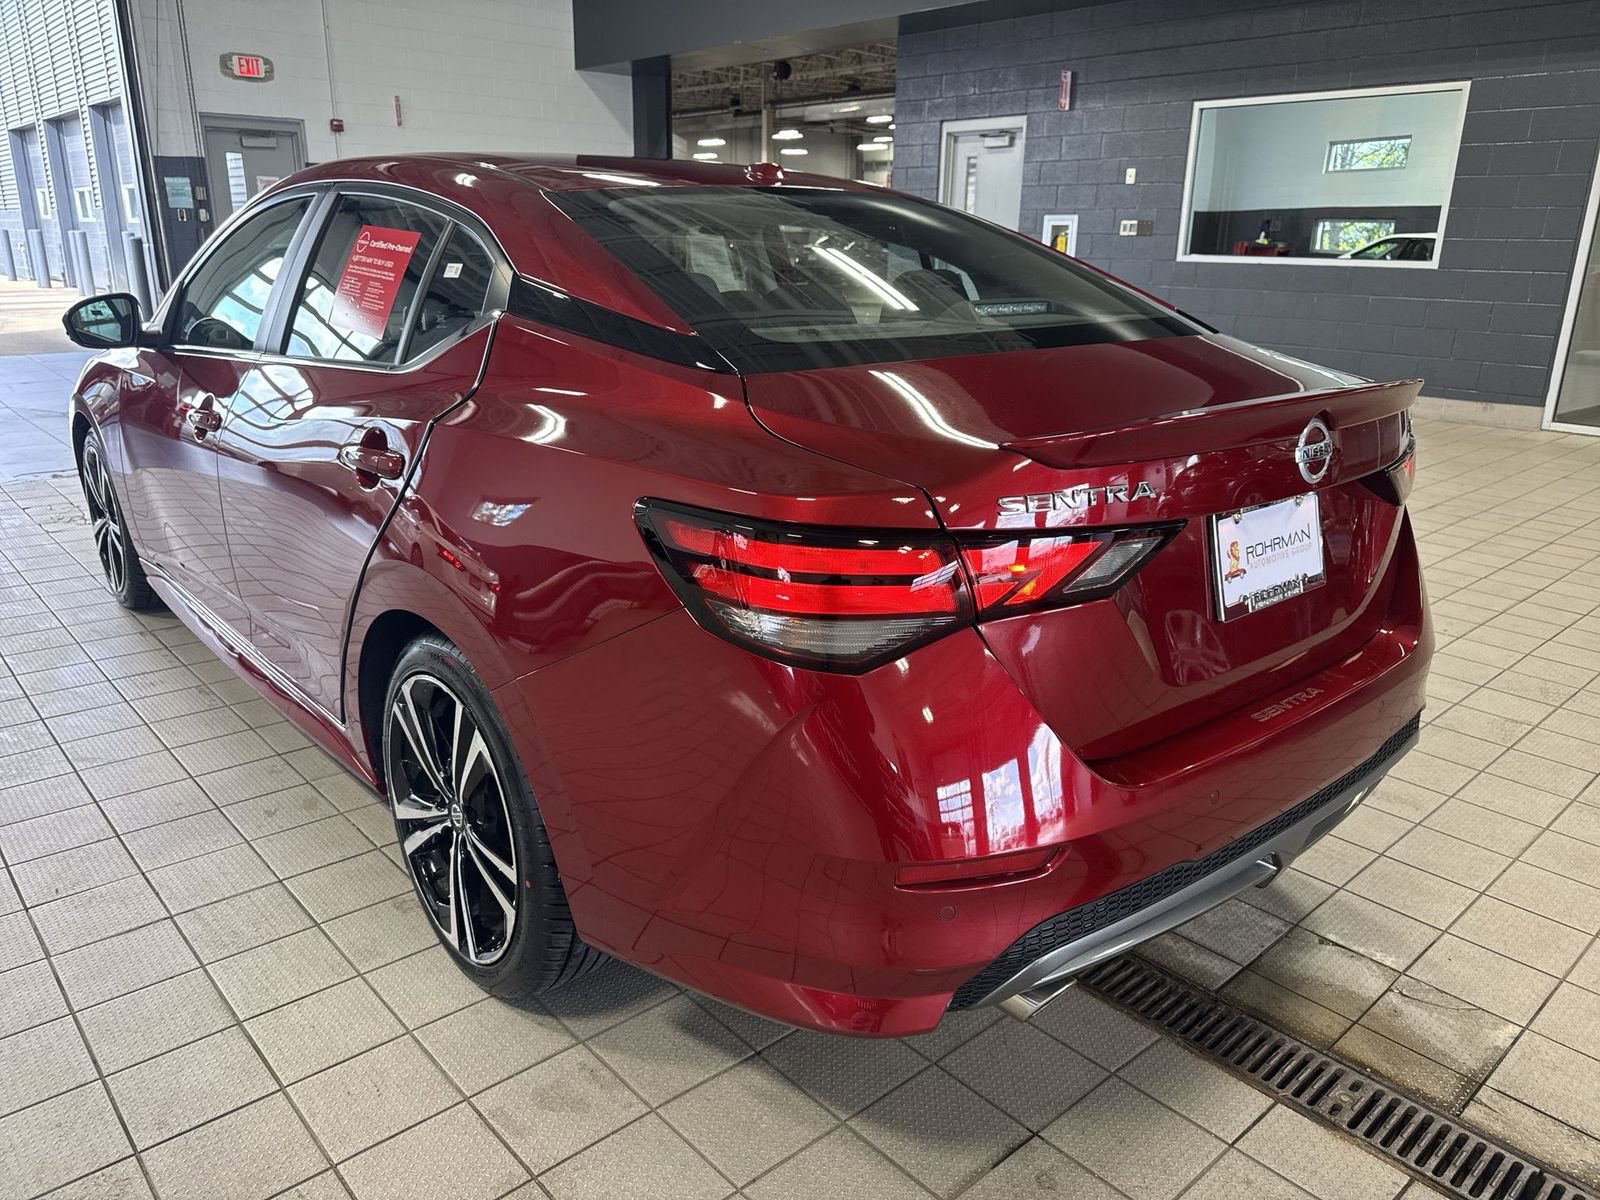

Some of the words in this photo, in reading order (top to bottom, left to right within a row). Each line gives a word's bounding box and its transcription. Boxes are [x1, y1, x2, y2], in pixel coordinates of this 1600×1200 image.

[238, 57, 260, 75] EXIT
[1302, 441, 1332, 460] NISSAN
[997, 481, 1157, 517] SENTRA
[1246, 523, 1312, 565] ROHRMAN
[1250, 548, 1290, 569] AUTOMOTIVE
[1291, 541, 1313, 555] GROUP
[1250, 687, 1325, 722] SENTRA
